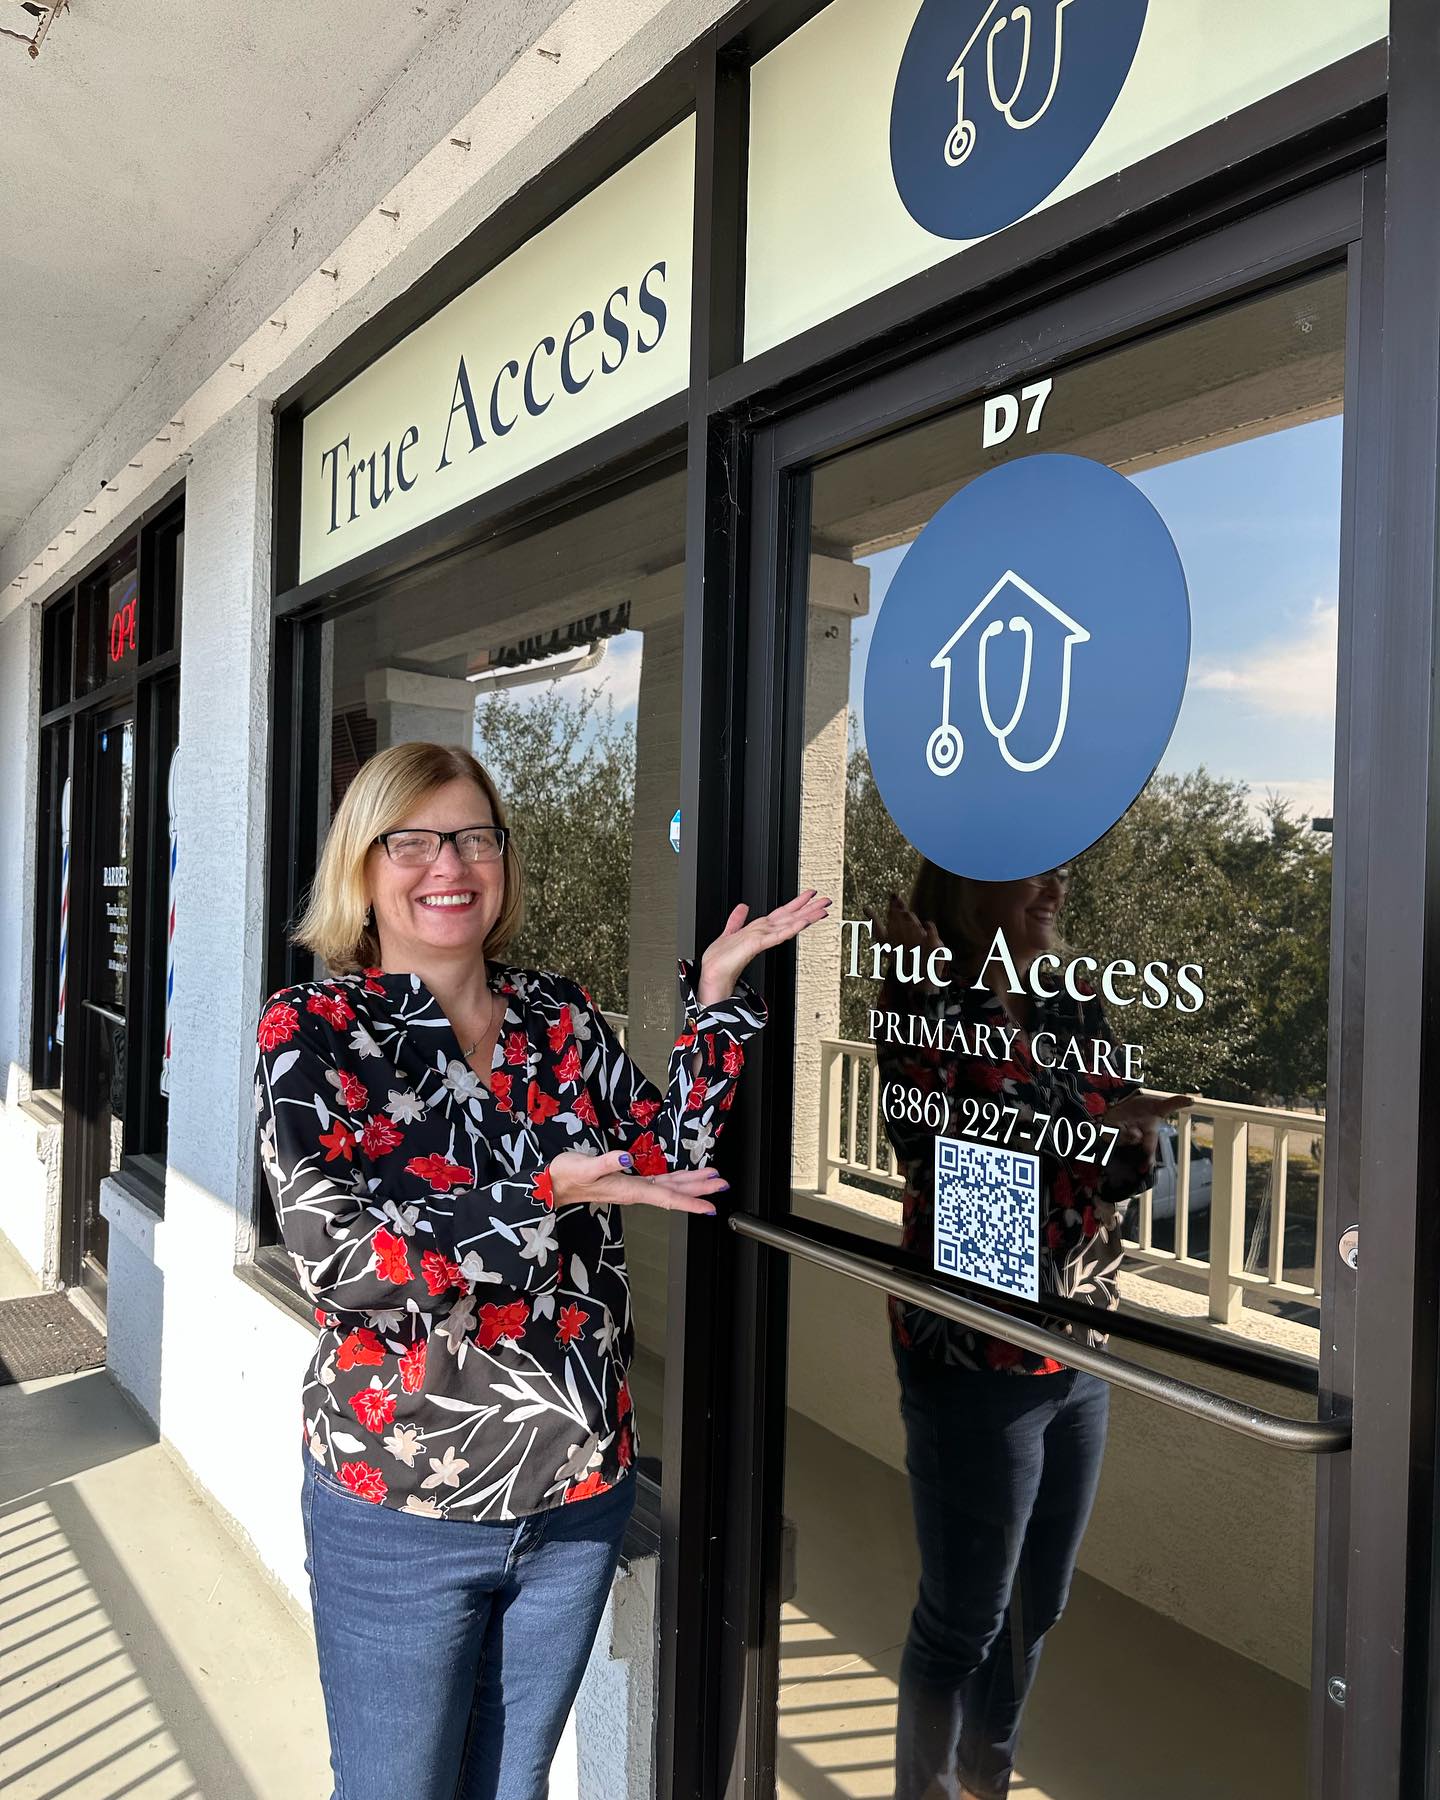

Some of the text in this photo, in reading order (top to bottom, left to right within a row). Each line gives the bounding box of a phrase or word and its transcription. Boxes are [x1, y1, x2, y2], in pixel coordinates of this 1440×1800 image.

[321, 260, 669, 536] True Access
[982, 377, 1053, 449] D7
[103, 866, 127, 887] BARBER
[840, 919, 1204, 1013] True Access
[868, 1009, 1145, 1083] PRIMARY CARE
[882, 1080, 1120, 1168] (386) 227-7027
